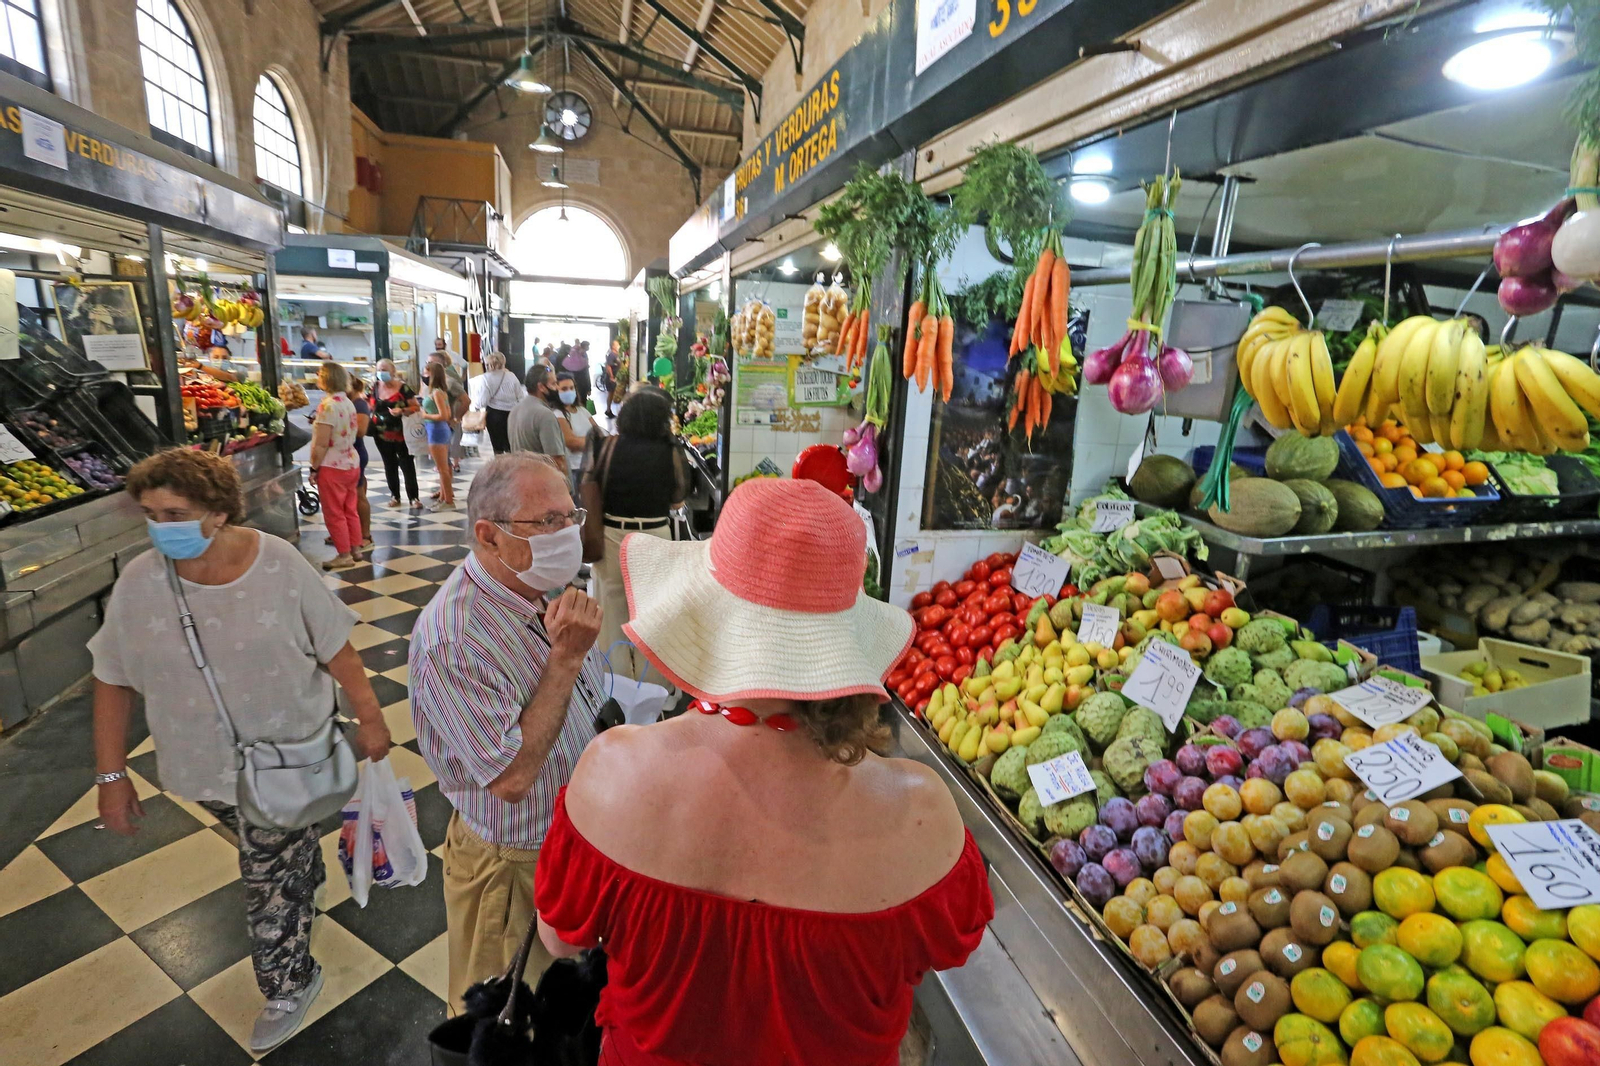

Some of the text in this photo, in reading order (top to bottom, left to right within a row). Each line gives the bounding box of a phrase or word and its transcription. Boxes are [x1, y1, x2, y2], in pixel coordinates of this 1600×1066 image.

[63, 129, 158, 182] VERDURAS
[735, 69, 841, 194] FRUTAS Y VERDURAS
[788, 117, 838, 185] ORTEGA
